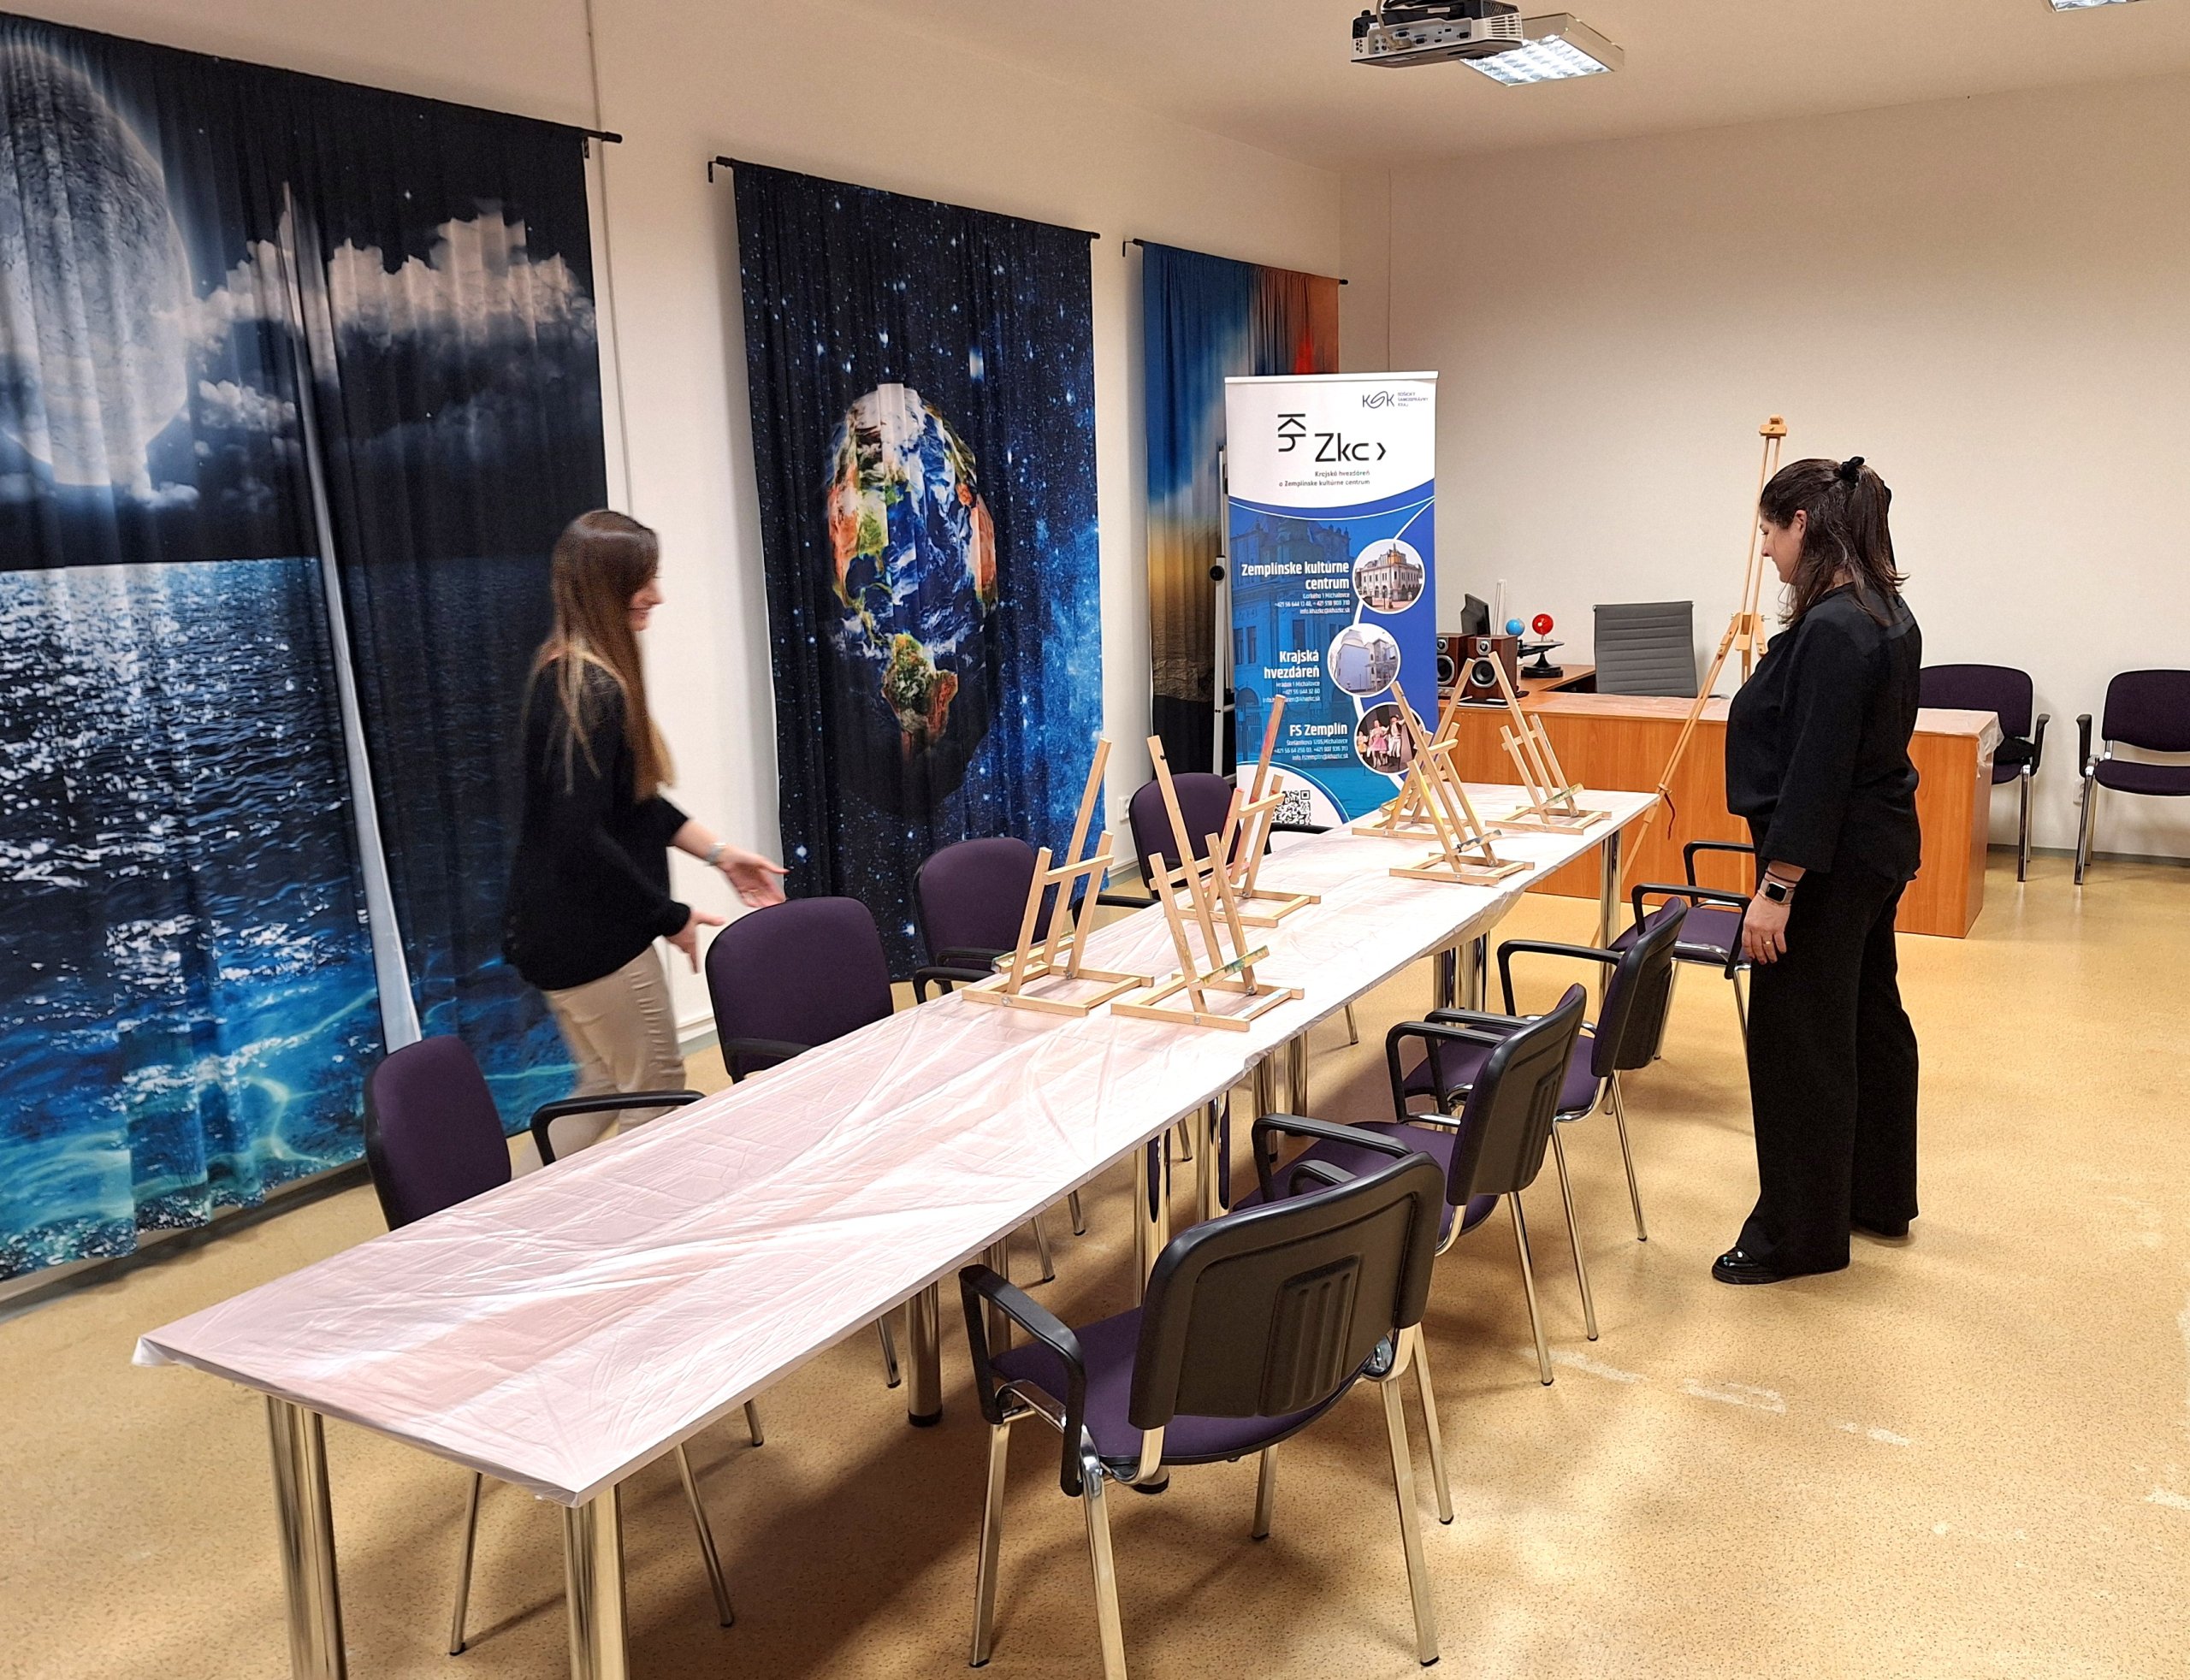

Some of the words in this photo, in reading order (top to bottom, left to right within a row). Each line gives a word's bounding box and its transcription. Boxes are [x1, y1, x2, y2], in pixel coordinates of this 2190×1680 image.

[1241, 561, 1302, 577] Zemplínske
[1304, 560, 1349, 574] kultúrne
[1305, 577, 1350, 590] centrum
[1279, 649, 1319, 665] Krajská
[1264, 665, 1320, 679] hvezdáreň
[1289, 725, 1302, 736] FS
[1305, 722, 1348, 737] Zemplín
